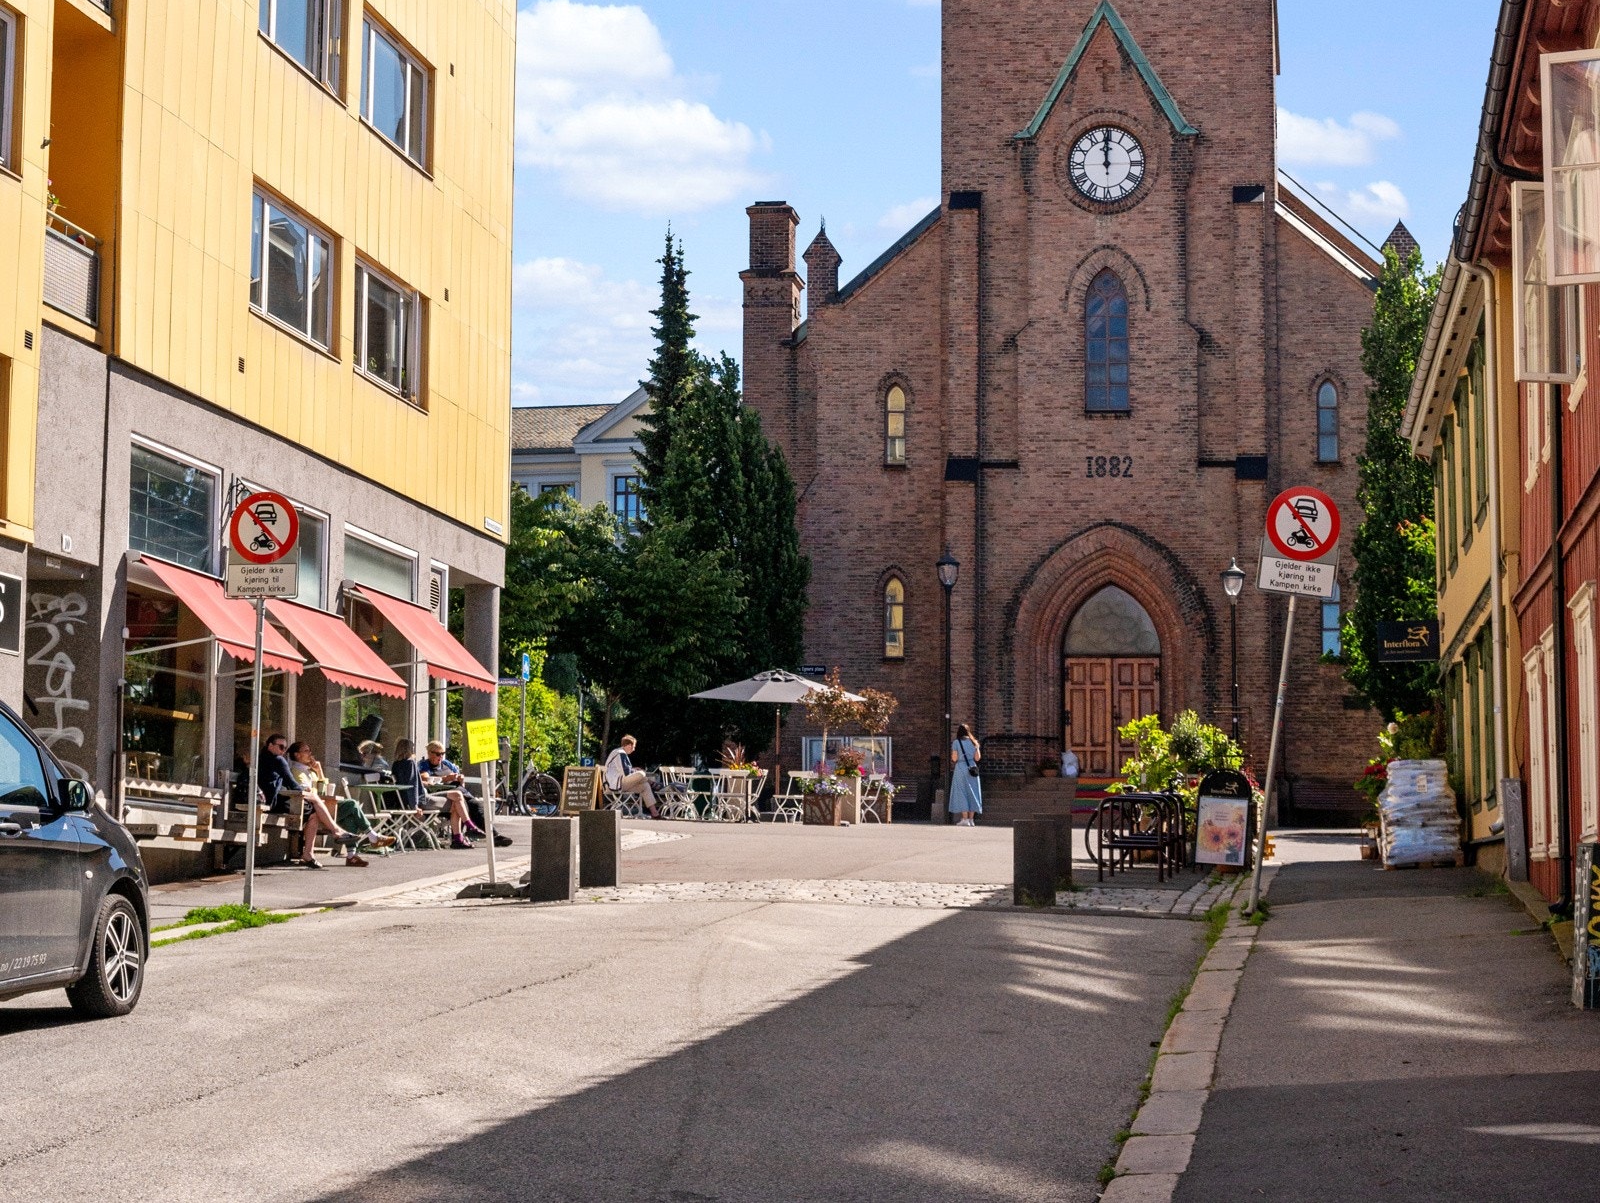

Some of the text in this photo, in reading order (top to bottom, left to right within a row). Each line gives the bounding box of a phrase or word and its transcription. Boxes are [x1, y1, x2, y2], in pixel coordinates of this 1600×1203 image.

[1086, 455, 1134, 478] 1882
[241, 566, 265, 575] Gjelder
[1275, 560, 1322, 574] Gjelder ikke
[244, 576, 269, 584] kjøring
[1278, 571, 1305, 582] kjøring
[237, 585, 265, 593] Kampen
[1269, 579, 1322, 593] Kampen kirke
[1383, 639, 1421, 648] Interflora
